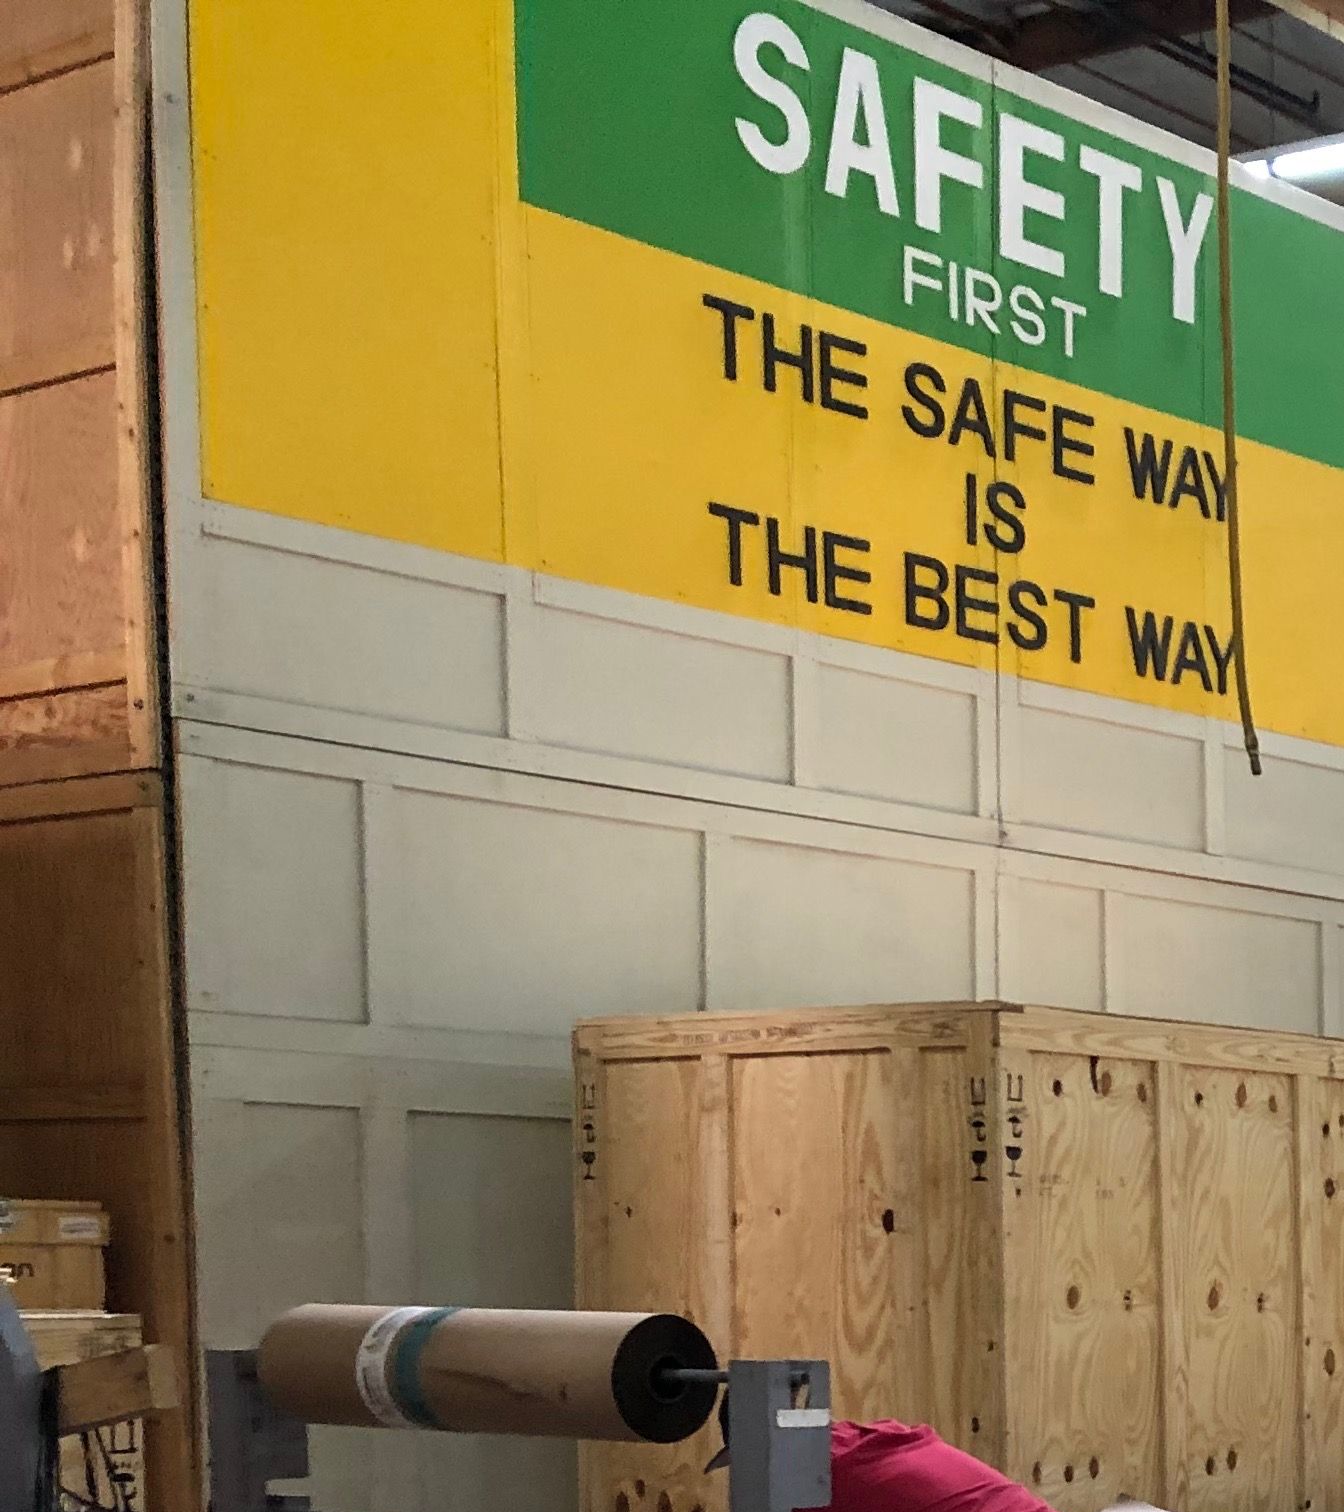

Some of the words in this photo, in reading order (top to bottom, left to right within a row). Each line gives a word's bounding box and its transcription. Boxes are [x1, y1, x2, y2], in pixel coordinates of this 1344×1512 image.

[733, 13, 1214, 324] SAFETY
[903, 245, 1087, 358] FIRST
[703, 294, 869, 420] THE
[901, 362, 1095, 486] SAFE
[1124, 427, 1236, 523] WAY
[708, 502, 872, 615] THE
[904, 552, 1095, 663] BEST
[1125, 605, 1239, 695] WAY
[966, 473, 1027, 554] IS
